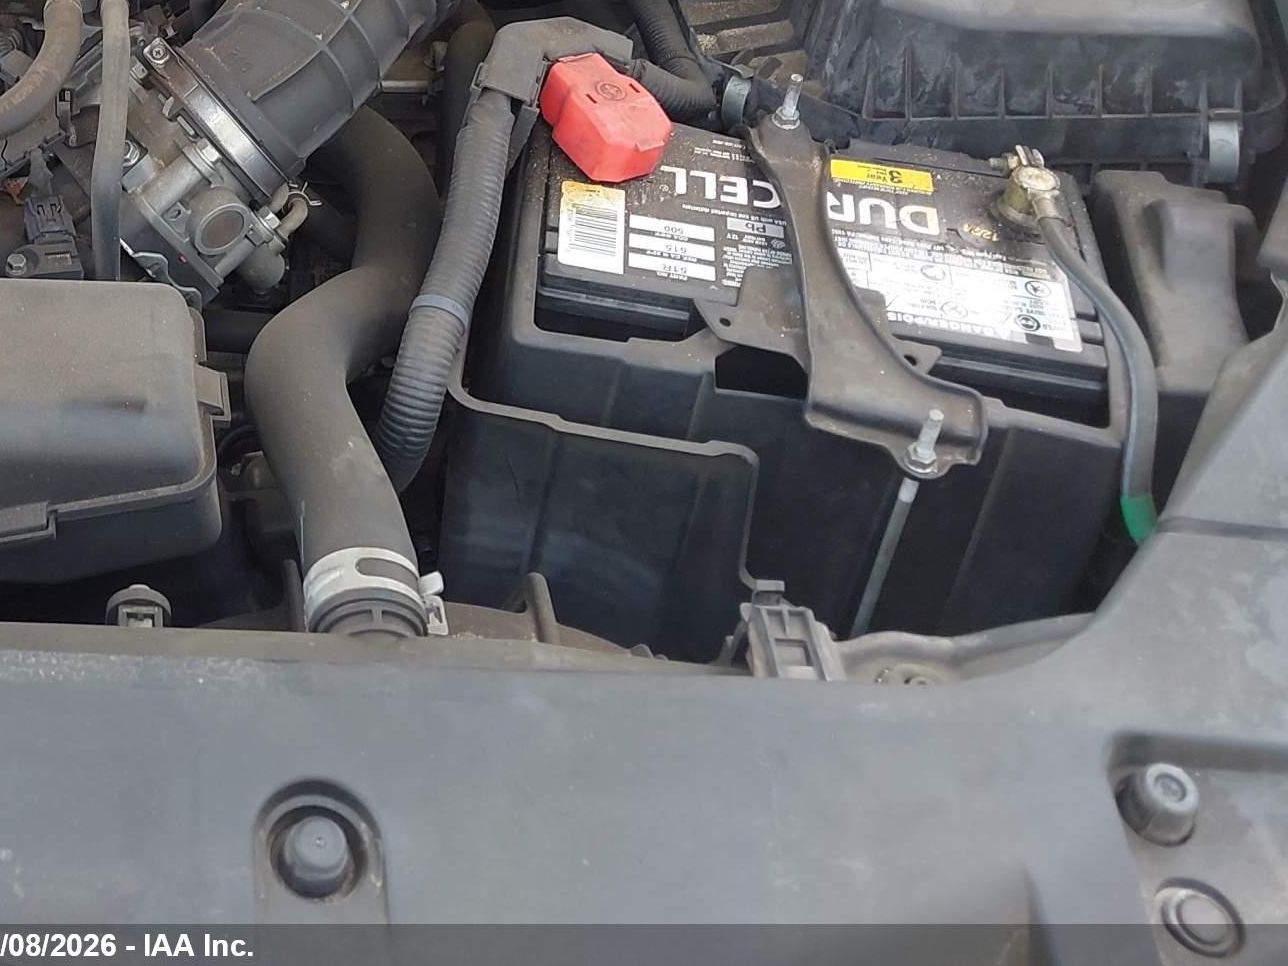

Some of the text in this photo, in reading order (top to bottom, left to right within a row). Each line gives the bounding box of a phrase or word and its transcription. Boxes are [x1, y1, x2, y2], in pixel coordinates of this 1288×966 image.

[888, 169, 904, 185] 3
[663, 225, 685, 235] 500
[745, 222, 766, 234] Pb
[665, 244, 688, 255] 515
[661, 264, 688, 275] 51R
